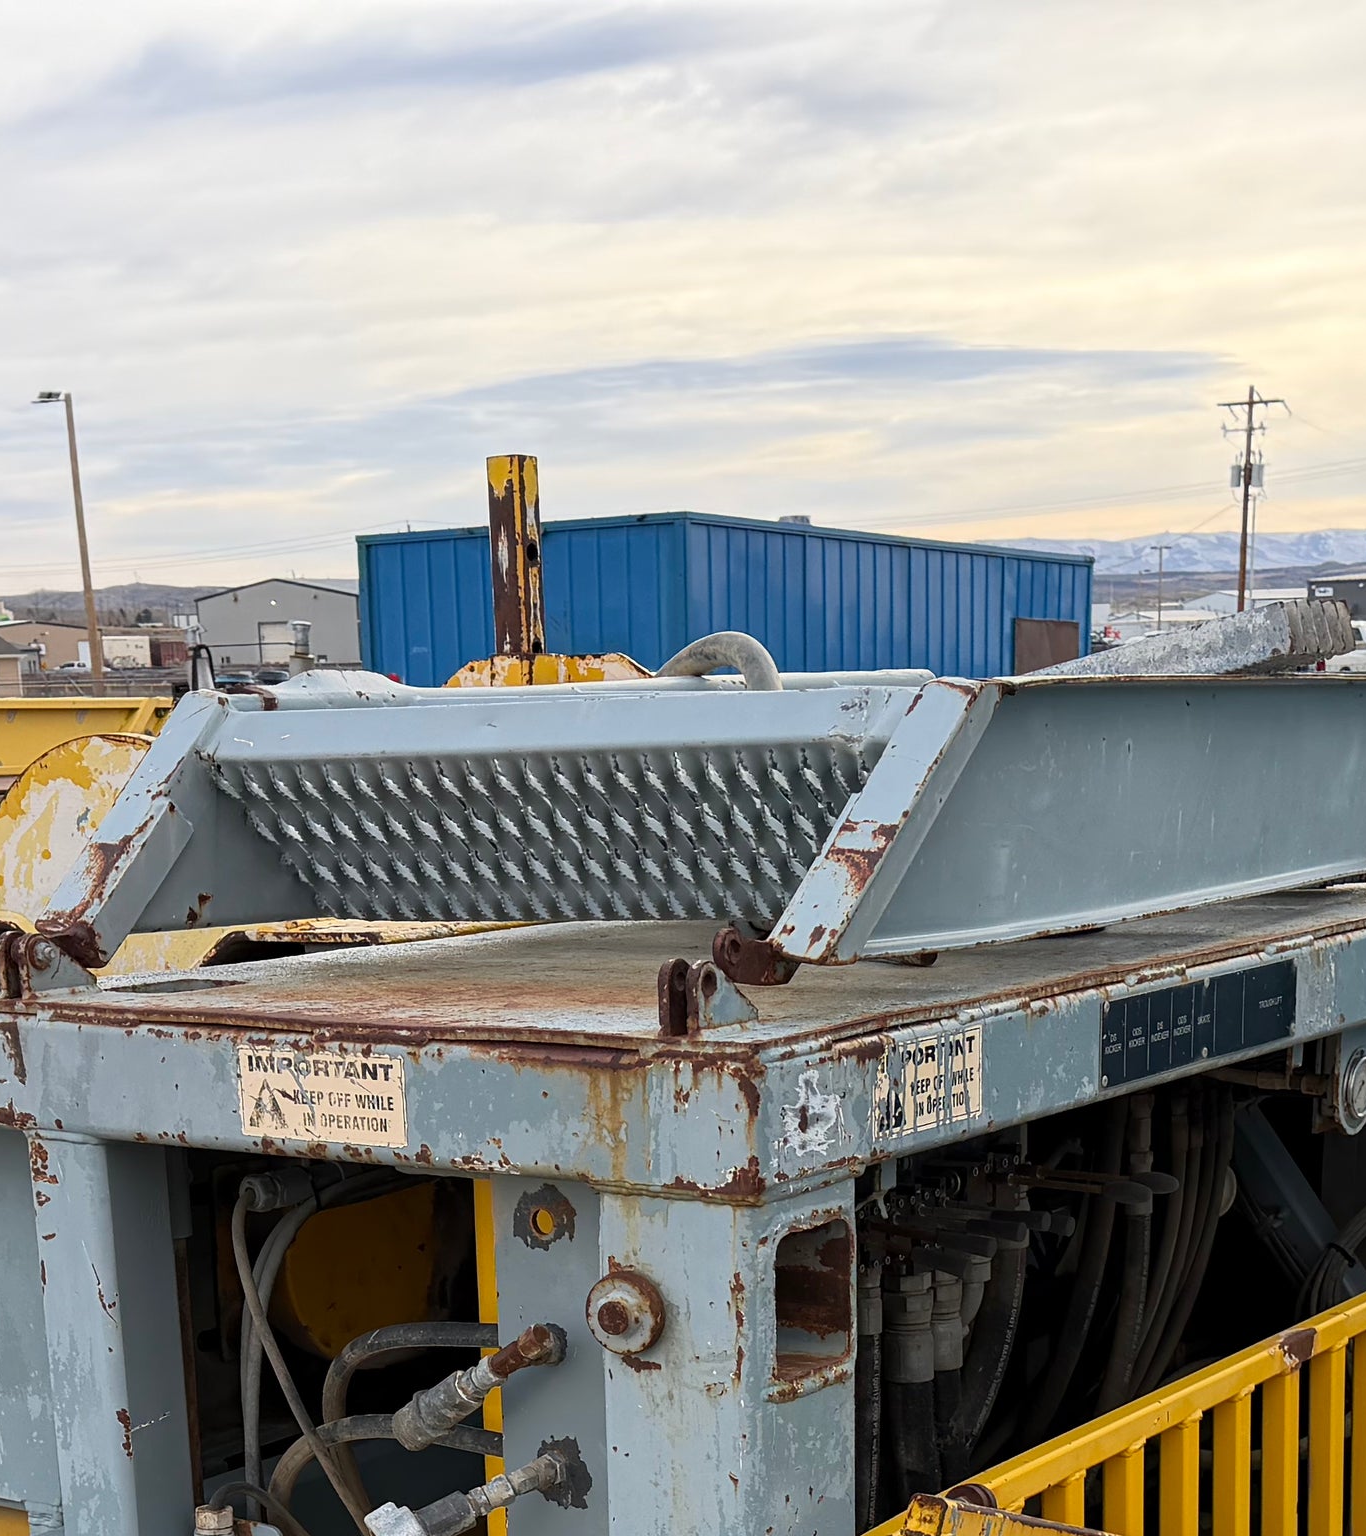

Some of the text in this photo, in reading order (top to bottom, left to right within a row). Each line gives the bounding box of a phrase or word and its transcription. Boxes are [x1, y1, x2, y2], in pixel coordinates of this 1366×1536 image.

[1128, 1037, 1145, 1048] KICKER
[247, 1055, 393, 1081] IMPORTANT
[293, 1089, 394, 1111] KEEP OFF WHILE
[303, 1112, 388, 1132] IN OPERATION
